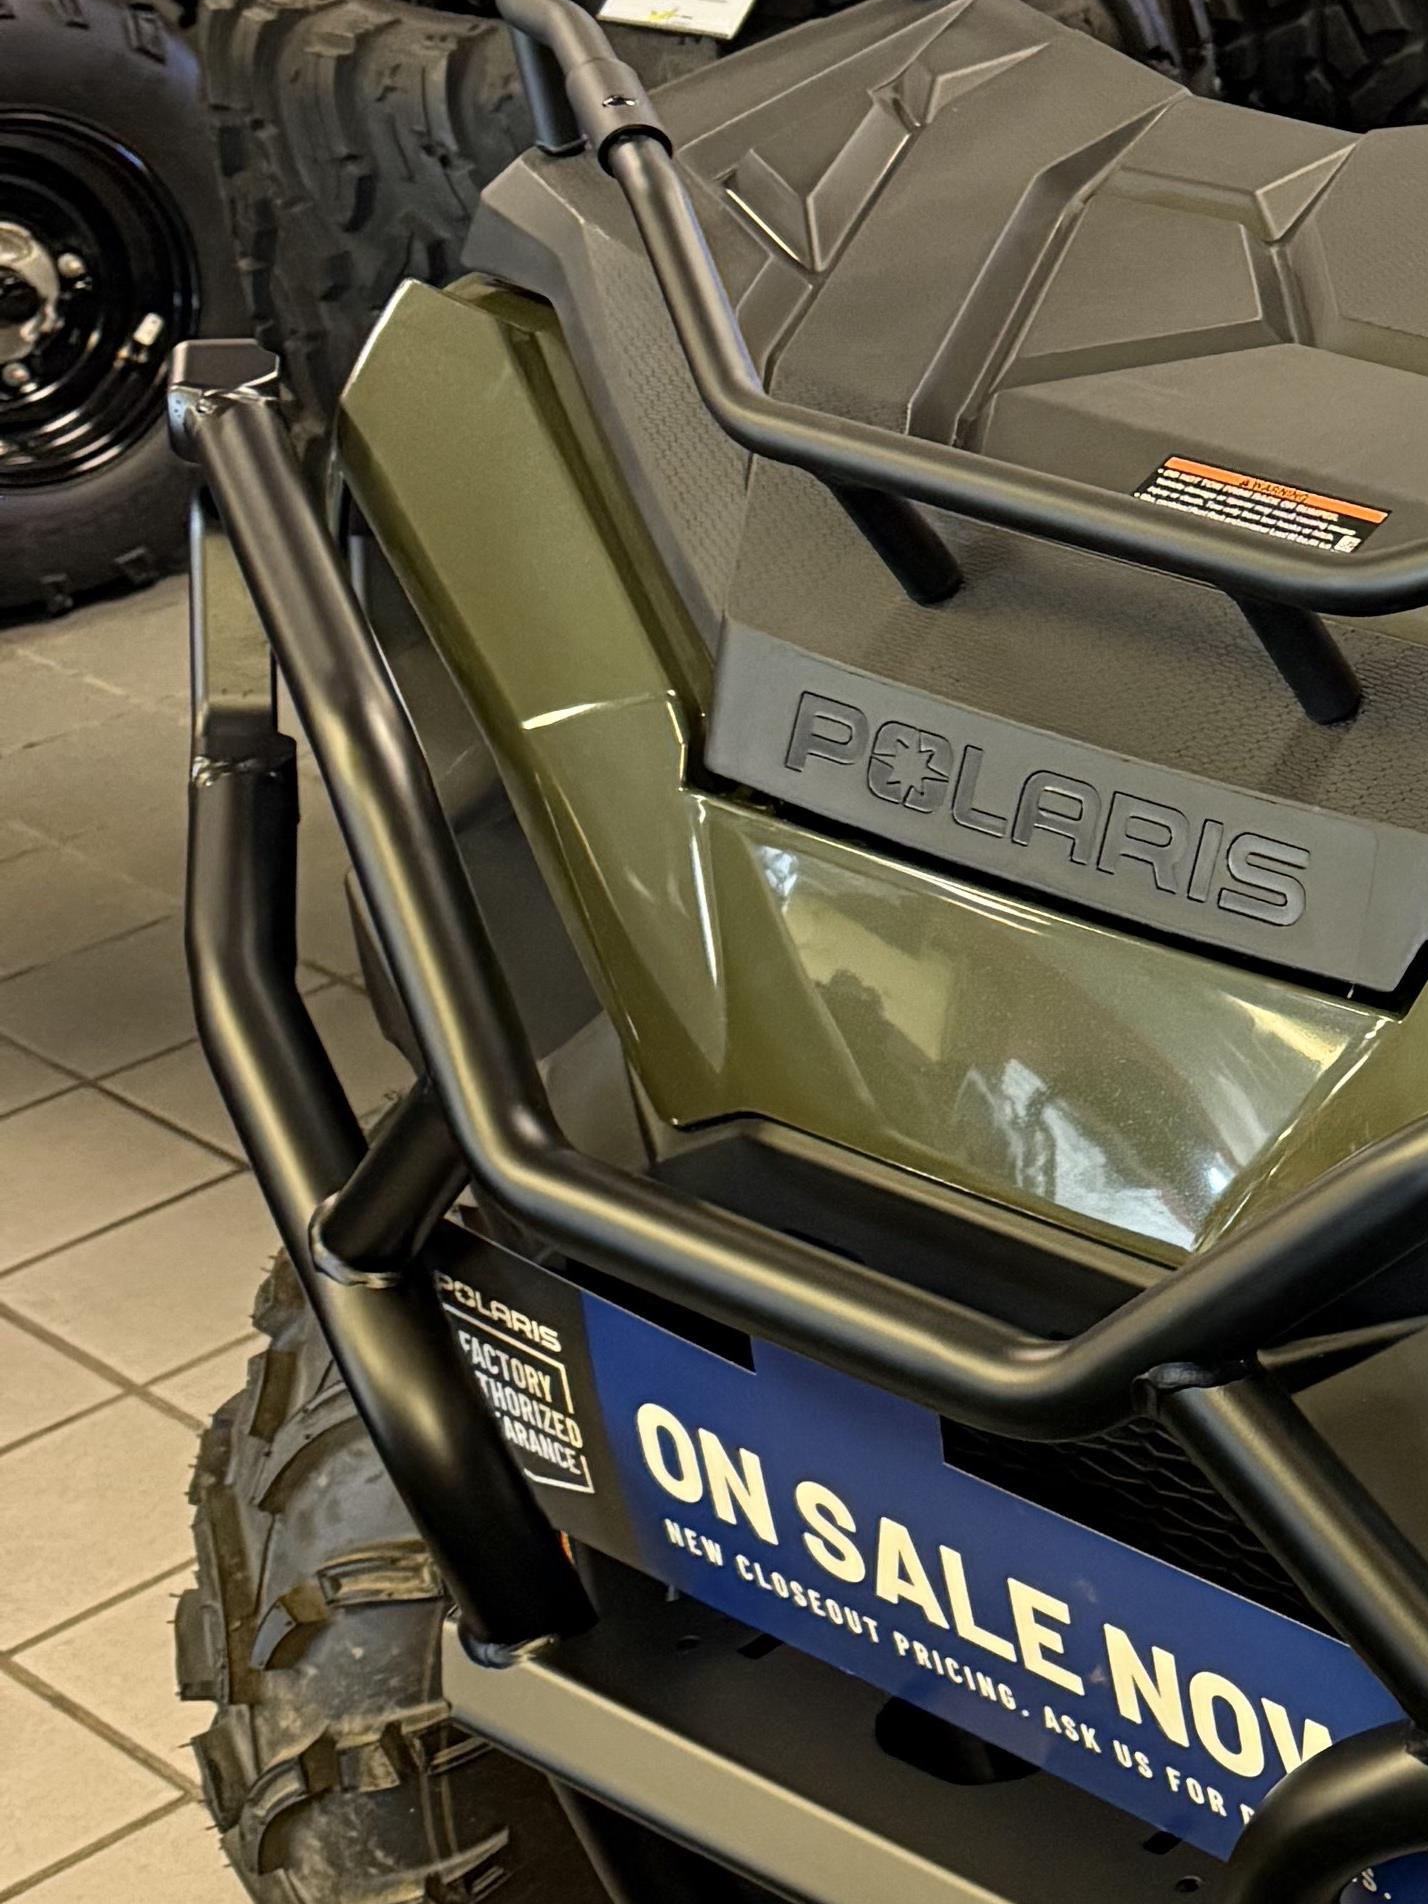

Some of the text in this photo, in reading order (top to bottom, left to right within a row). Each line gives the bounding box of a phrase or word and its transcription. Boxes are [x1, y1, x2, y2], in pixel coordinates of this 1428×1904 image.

[1250, 479, 1309, 502] WARNING
[785, 690, 1311, 928] POLARIS
[435, 1270, 562, 1354] POLARIS
[457, 1329, 554, 1403] FACTORY
[474, 1368, 583, 1450] THORIZED
[494, 1411, 582, 1475] ARANCE
[636, 1402, 779, 1546] ON
[795, 1481, 1085, 1696] SALE
[664, 1518, 723, 1567] NEW
[735, 1554, 879, 1643] CLOSEOUT
[1043, 1705, 1102, 1754] ASK
[1113, 1739, 1153, 1779] US
[1166, 1765, 1227, 1817] FOR
